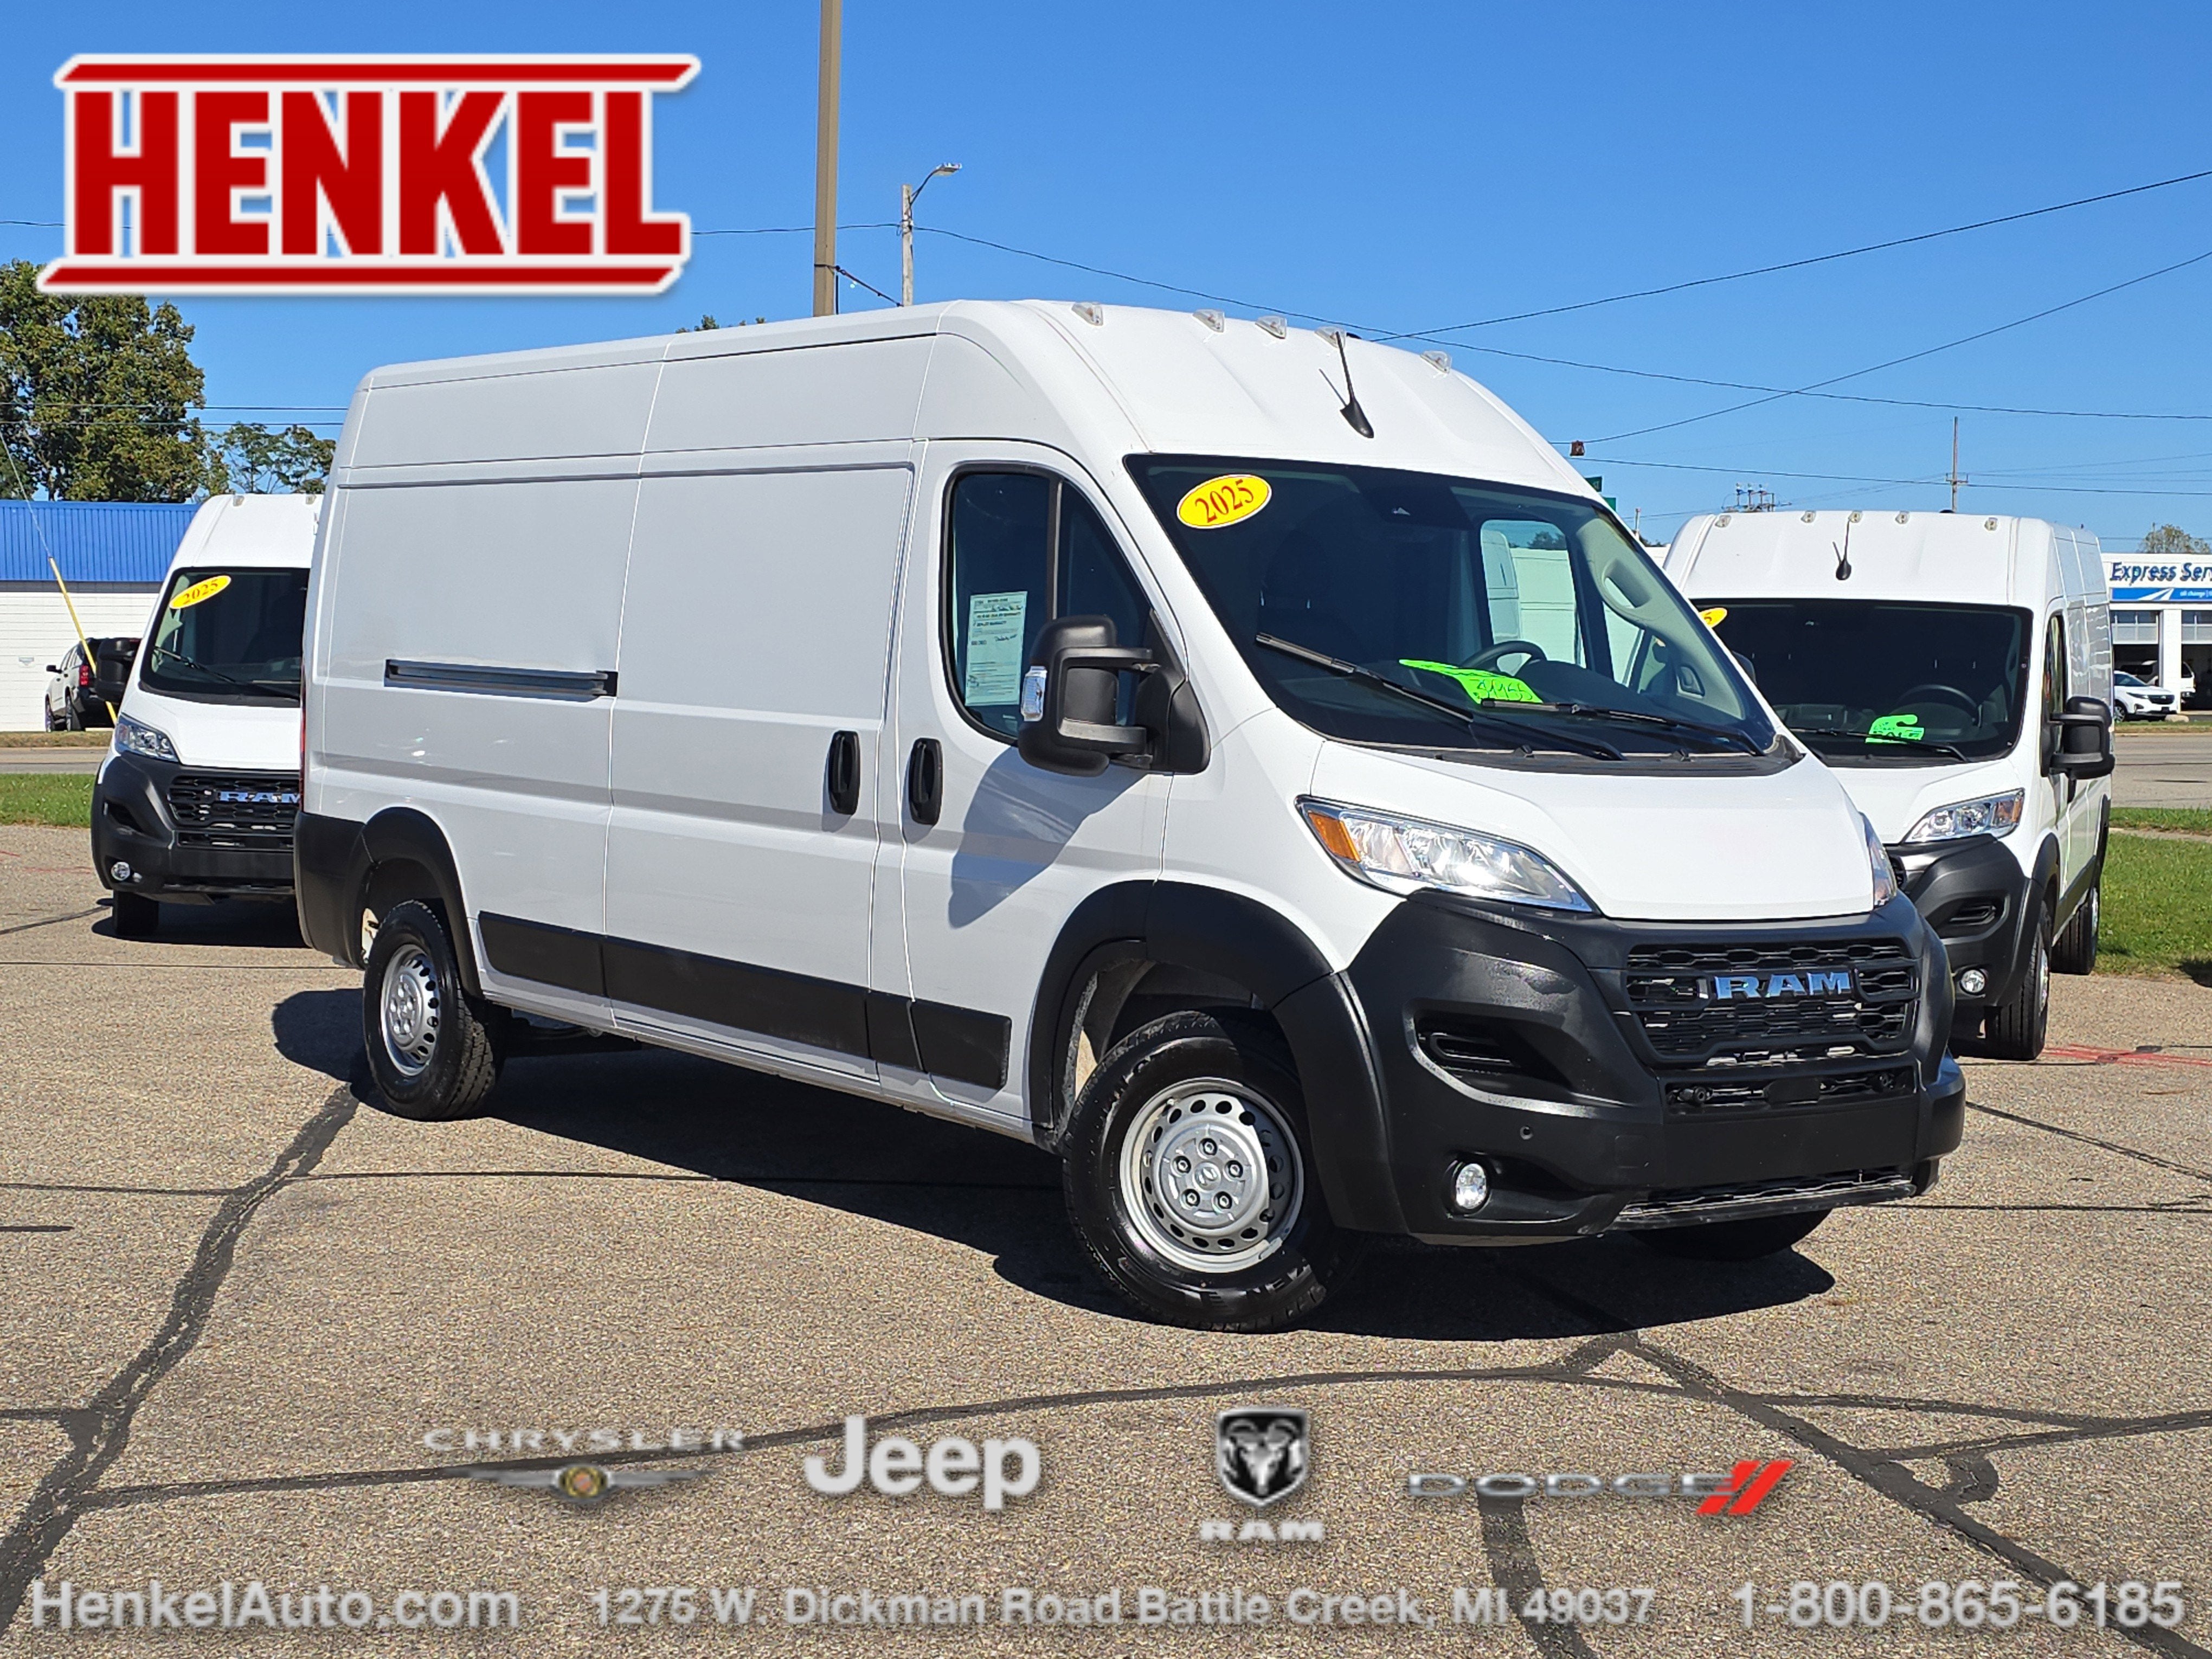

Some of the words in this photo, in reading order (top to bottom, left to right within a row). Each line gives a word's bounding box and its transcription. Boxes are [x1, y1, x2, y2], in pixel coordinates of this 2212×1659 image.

[1194, 479, 1255, 523] 2025
[2110, 562, 2177, 586] Express
[2180, 562, 2212, 581] Ser
[182, 578, 218, 605] 2025
[218, 792, 300, 803] RAM
[1714, 972, 1851, 1000] RAM
